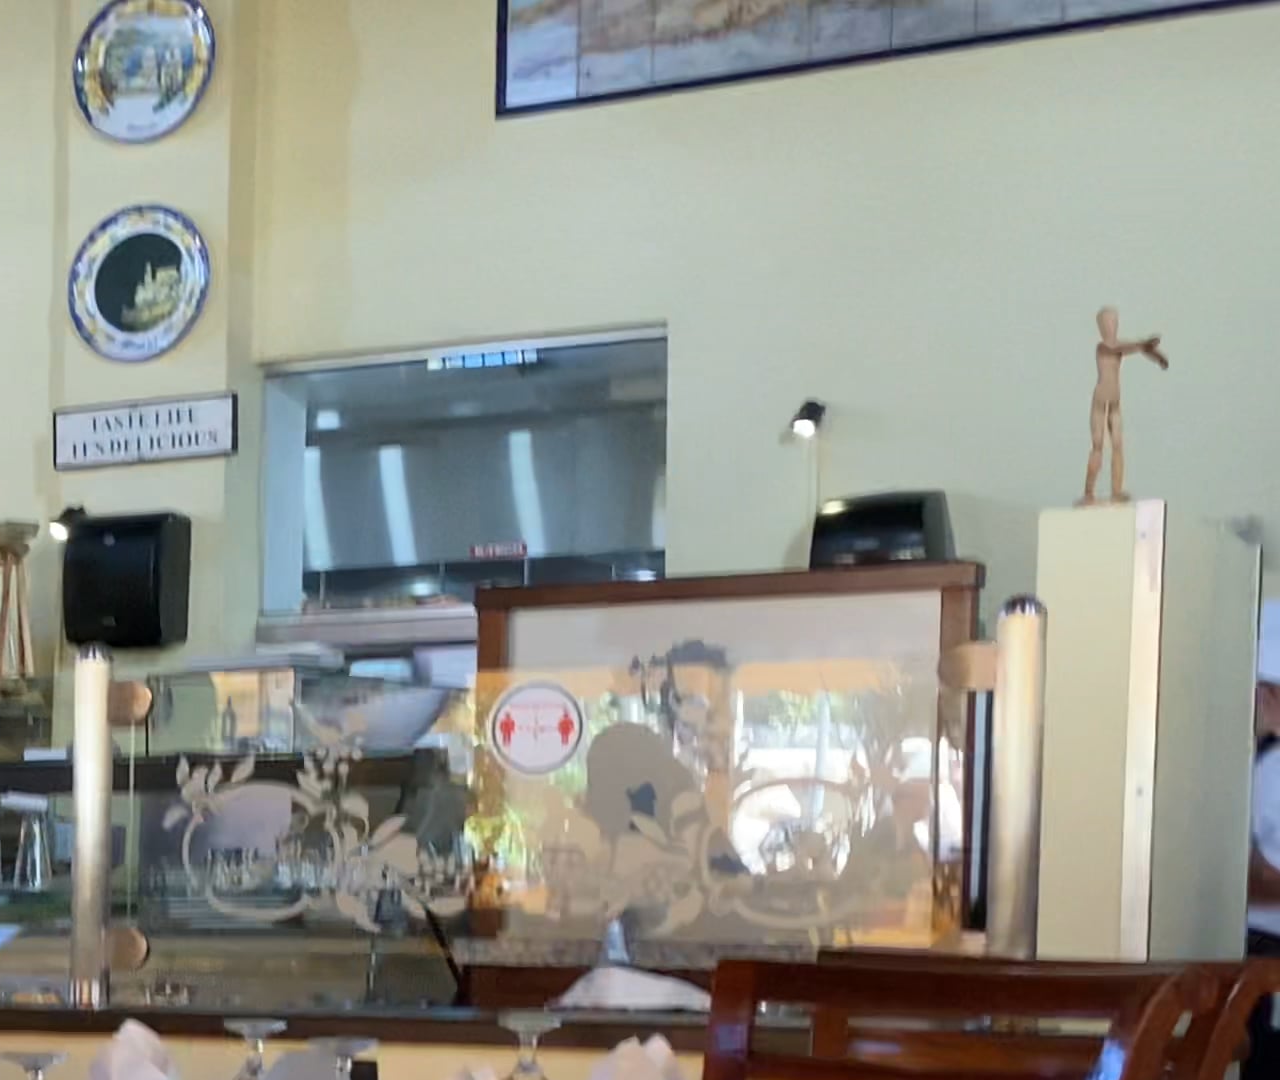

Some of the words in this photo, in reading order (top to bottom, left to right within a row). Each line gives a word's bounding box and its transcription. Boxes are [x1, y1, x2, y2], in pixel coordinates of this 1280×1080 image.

[90, 410, 147, 433] TASTE
[153, 406, 198, 427] LIFE
[107, 428, 219, 454] DELICIOUS
